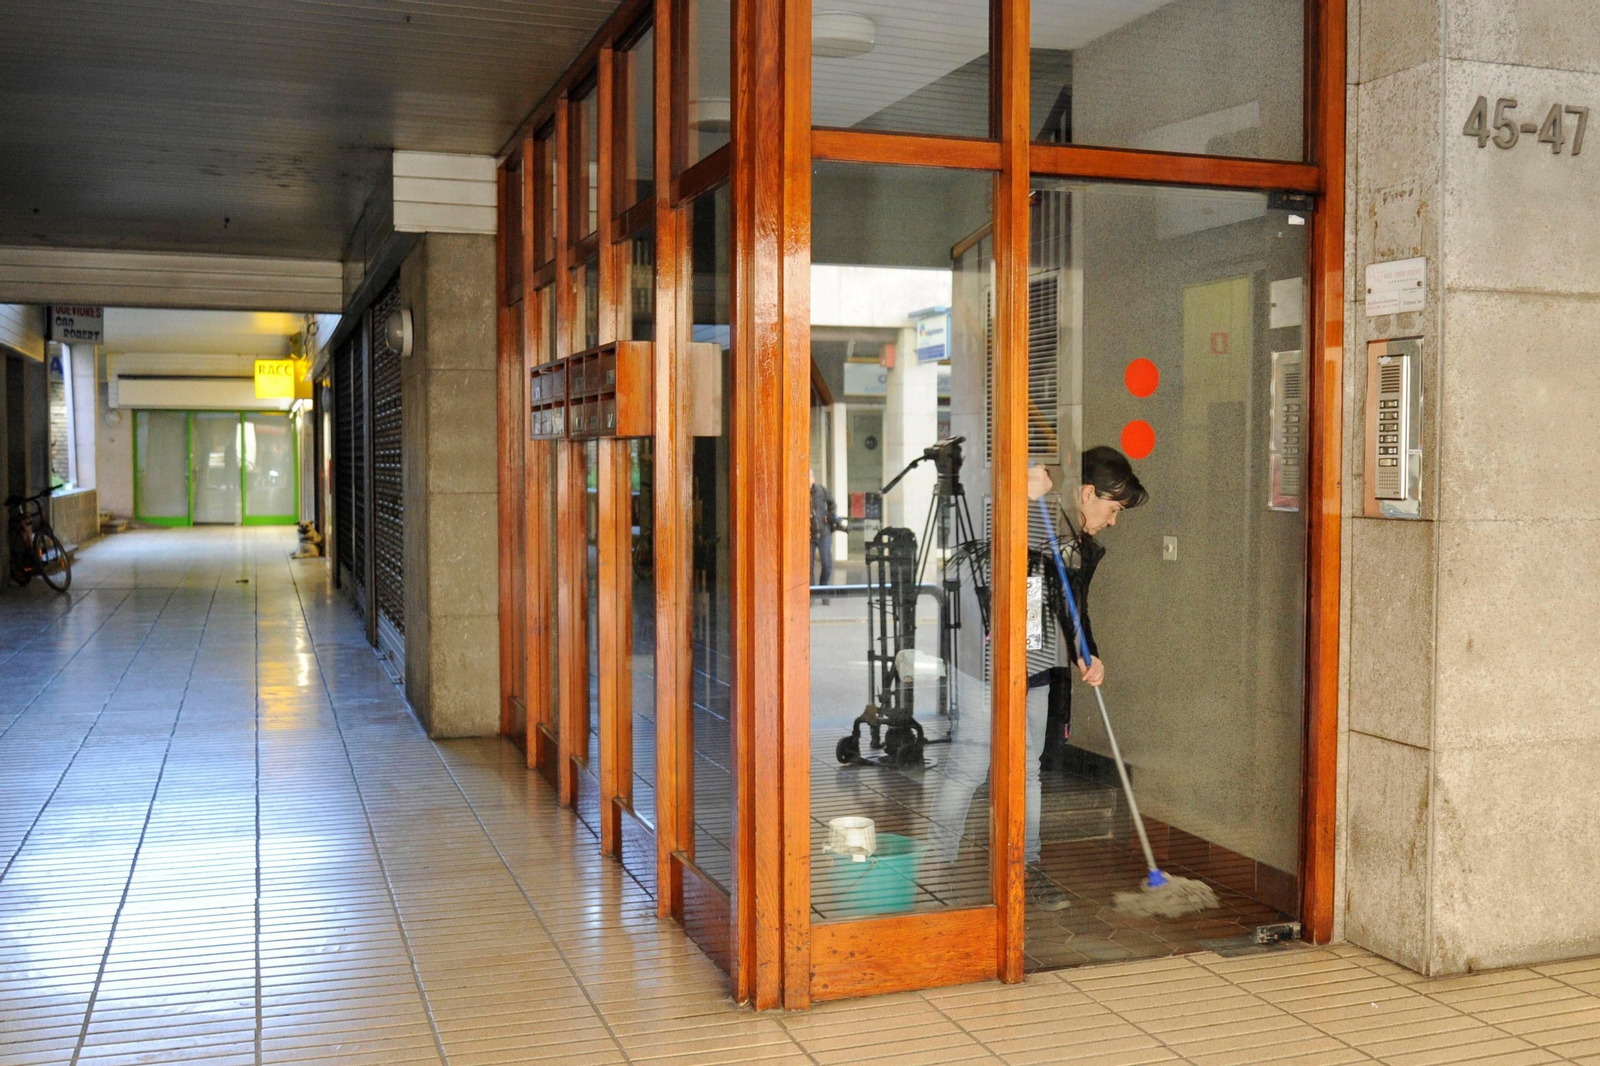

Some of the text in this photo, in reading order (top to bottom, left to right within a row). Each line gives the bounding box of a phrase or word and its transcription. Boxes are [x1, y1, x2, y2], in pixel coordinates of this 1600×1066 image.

[1463, 95, 1590, 156] 45-47
[63, 328, 100, 340] ROBERT
[258, 364, 292, 376] RACC
